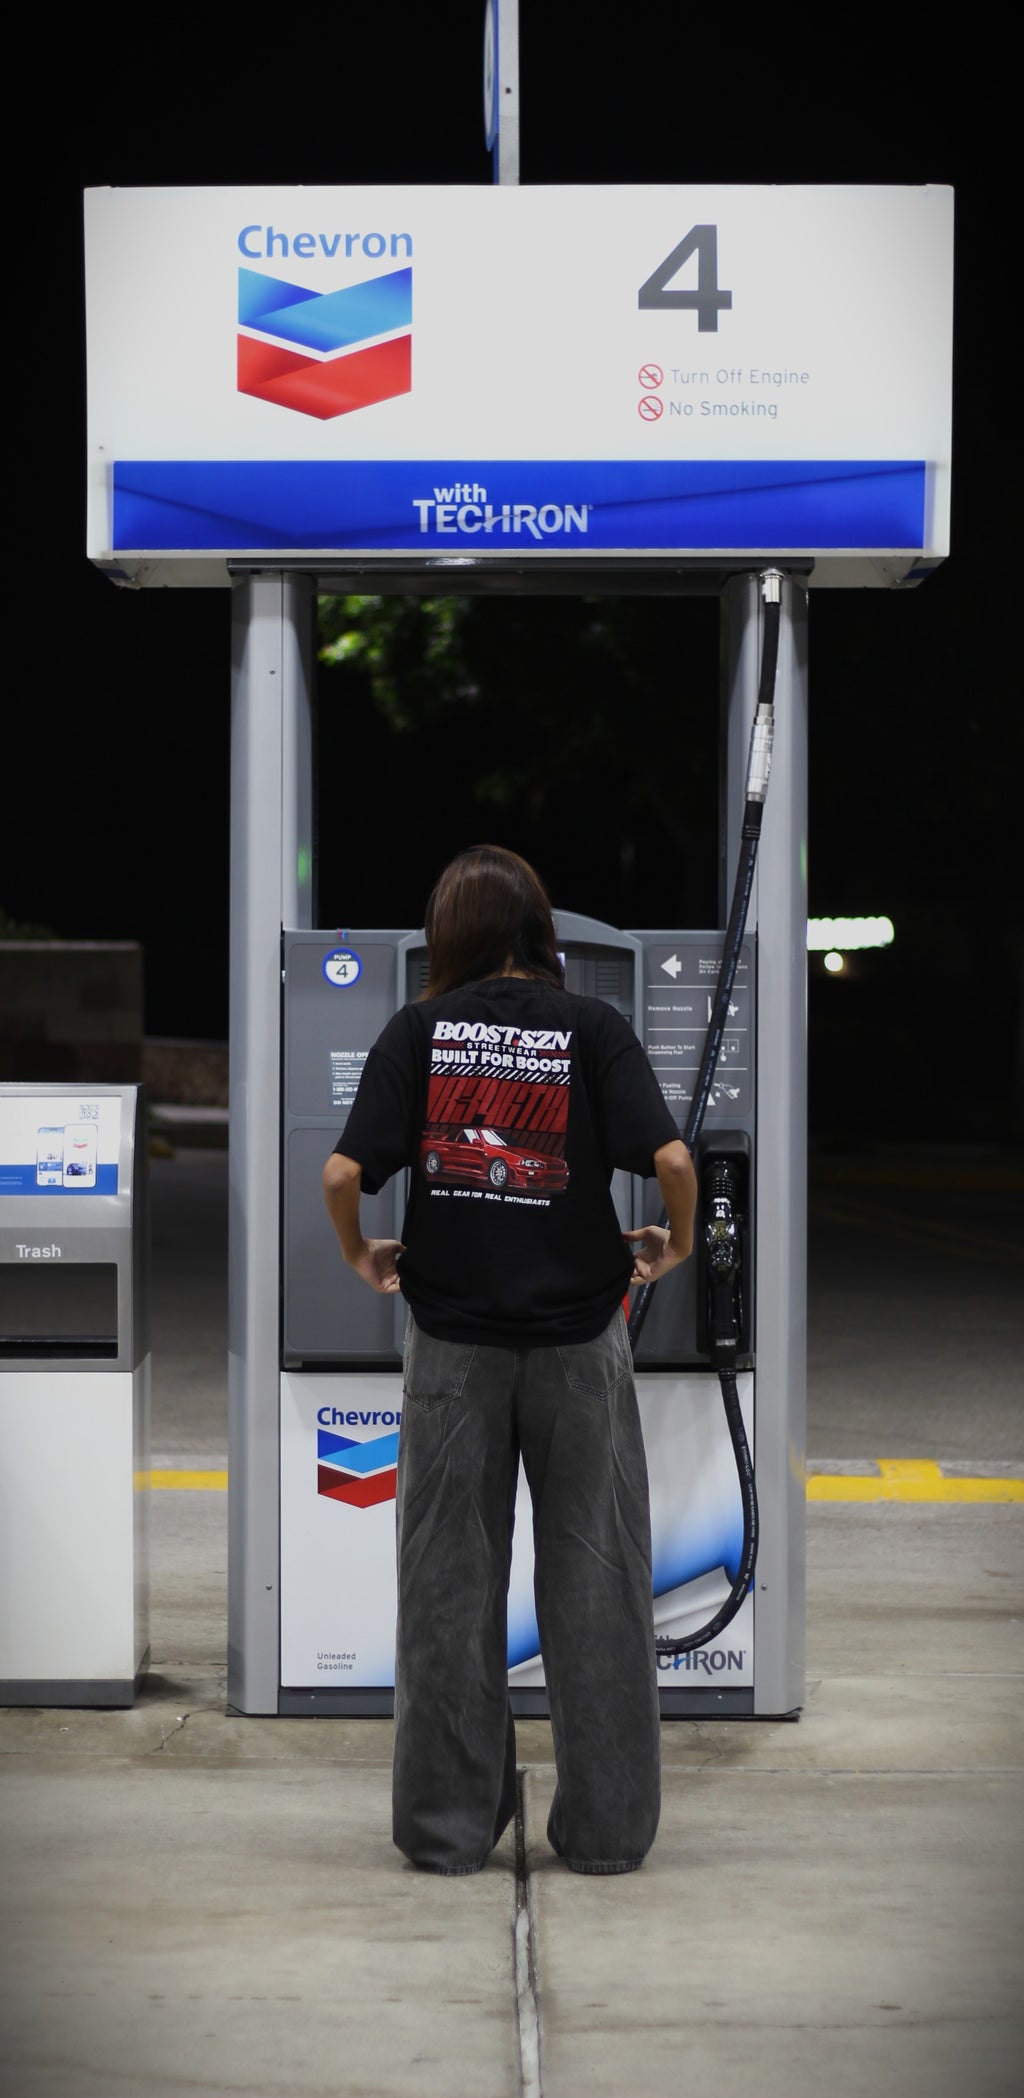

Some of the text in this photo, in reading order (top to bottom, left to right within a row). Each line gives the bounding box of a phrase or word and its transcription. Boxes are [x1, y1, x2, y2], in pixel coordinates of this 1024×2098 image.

[236, 225, 414, 259] Chevron
[638, 224, 733, 333] 4
[671, 369, 810, 387] Turn Off Engine
[670, 401, 778, 419] No Smoking
[433, 483, 487, 503] with
[412, 499, 588, 540] TECHRON
[336, 964, 348, 978] 4
[466, 1042, 537, 1057] STREETWEAR
[432, 1049, 571, 1073] BUILT FOR BOOST
[431, 1189, 450, 1197] REAL
[453, 1190, 470, 1198] GEAR
[484, 1192, 502, 1201] REAL
[504, 1195, 551, 1206] ENTHUSIASTS
[16, 1244, 62, 1258] Trash
[317, 1652, 357, 1660] Unleaded
[317, 1662, 353, 1670] Gasoline
